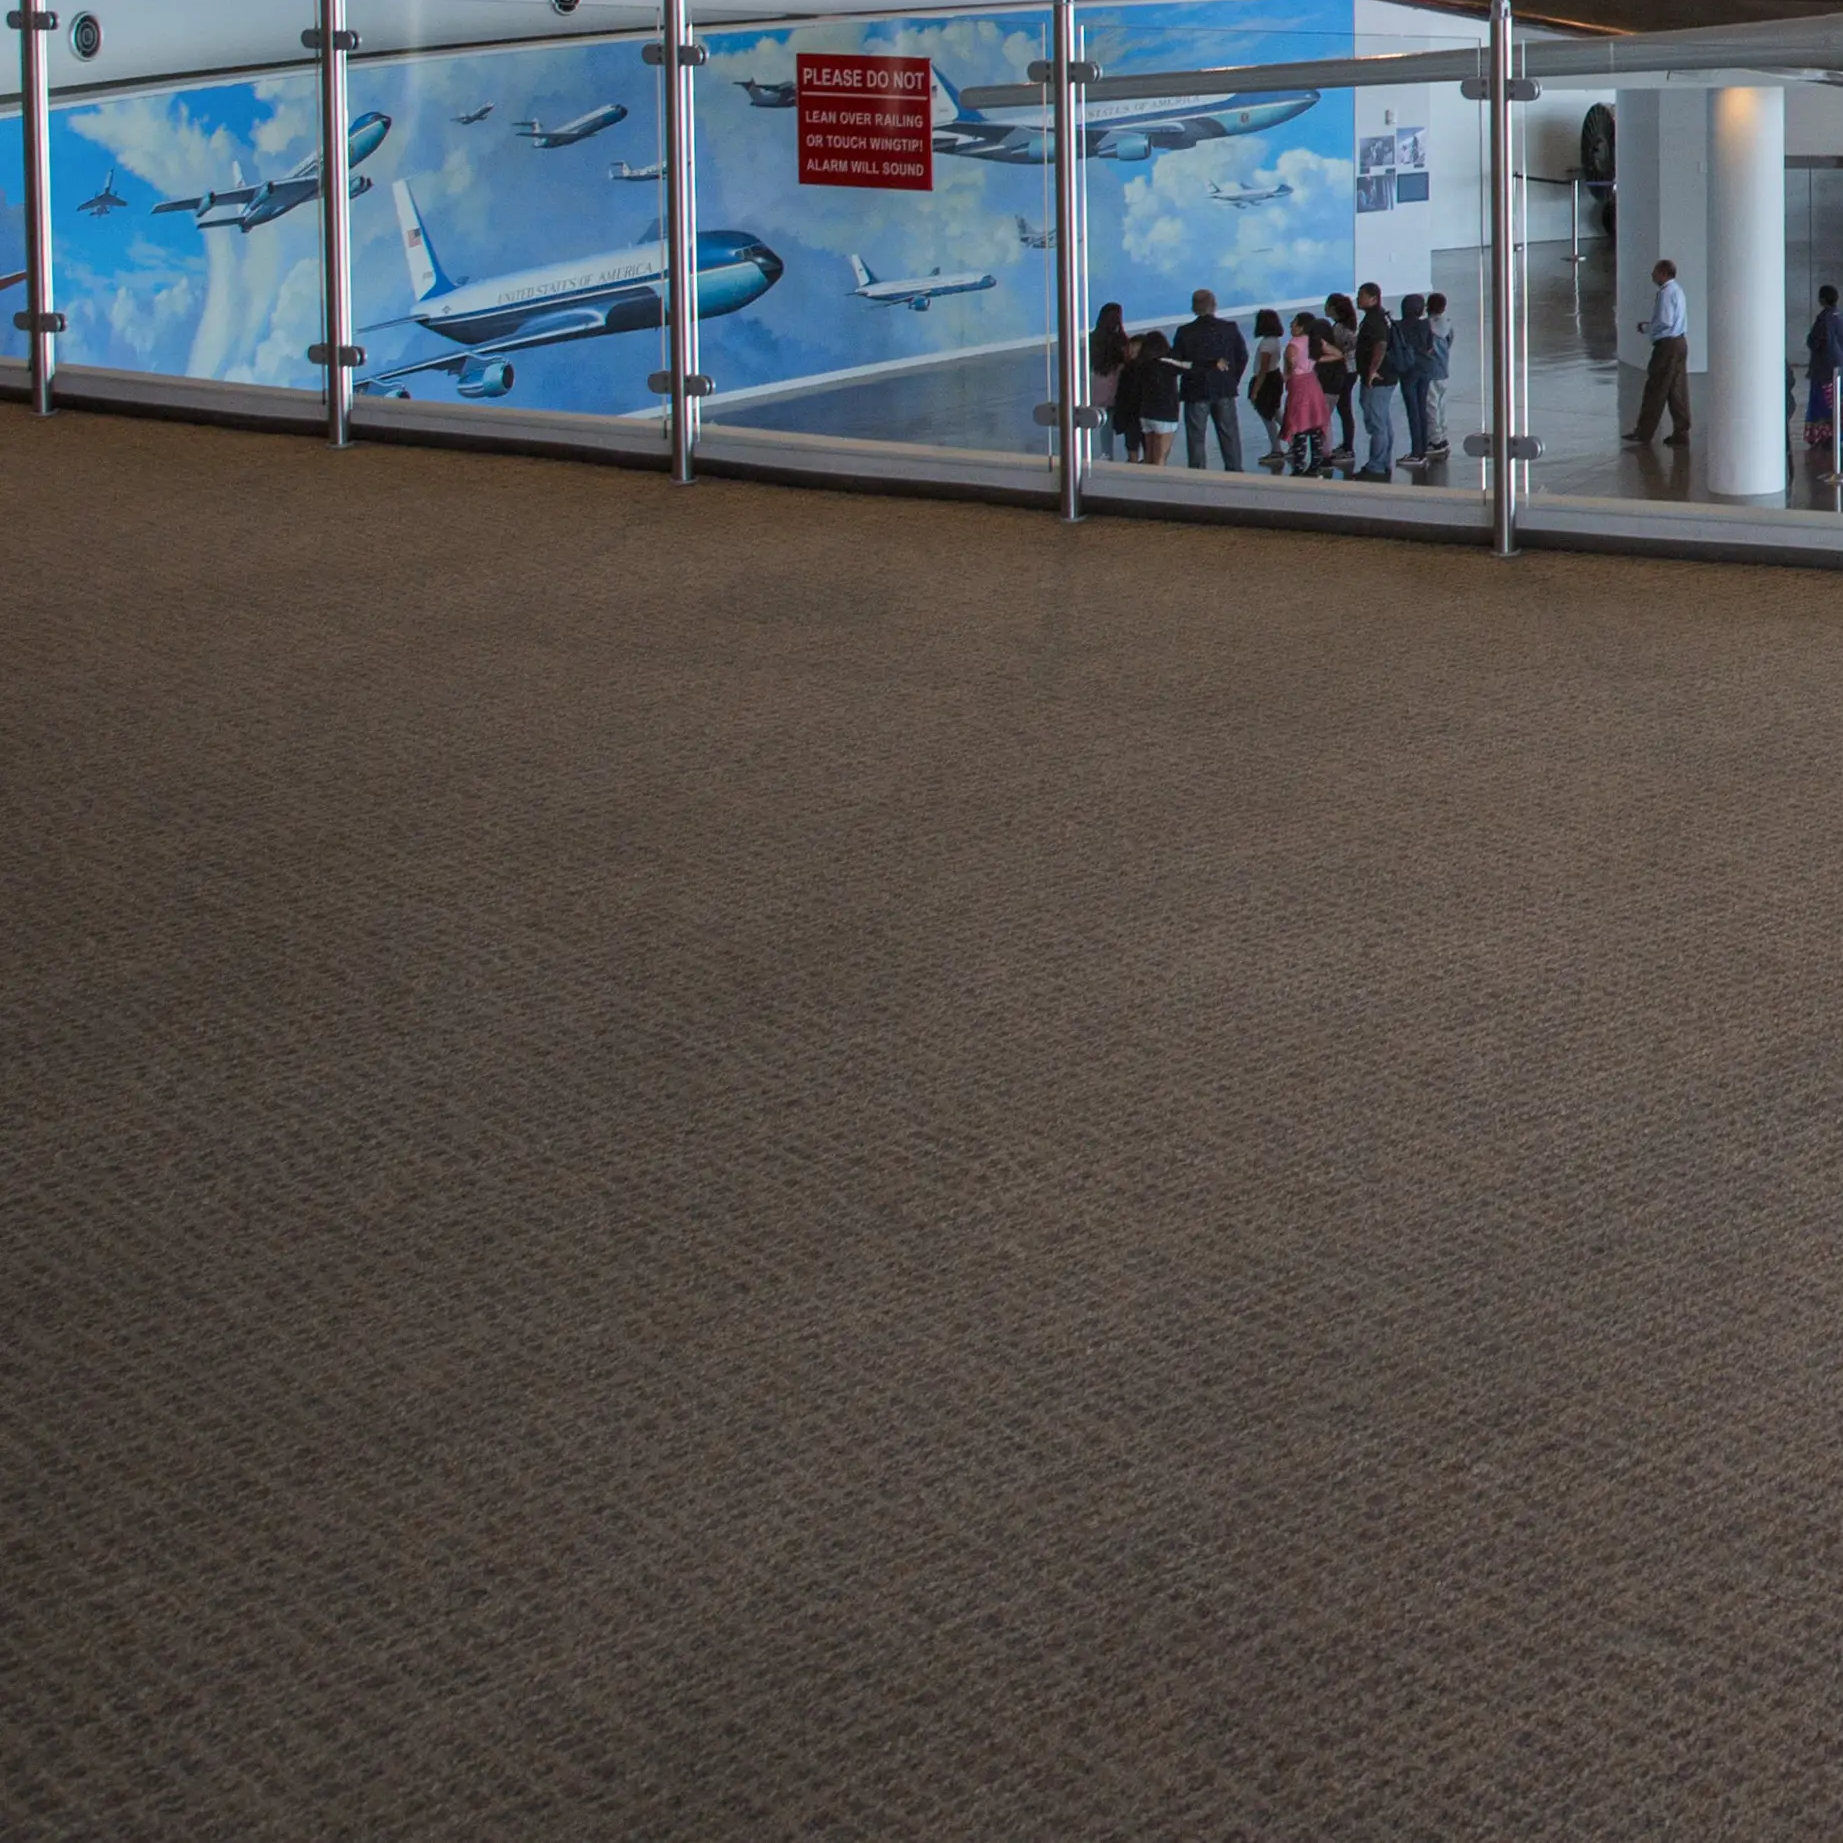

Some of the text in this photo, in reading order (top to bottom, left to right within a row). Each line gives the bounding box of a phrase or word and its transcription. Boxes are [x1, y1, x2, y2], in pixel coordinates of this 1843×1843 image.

[803, 67, 925, 90] PLEASE DO NOT
[805, 110, 924, 129] LEAN OVER RAILING
[806, 133, 924, 153] OR TOUCH WINGTIP!
[806, 158, 924, 177] ALARM WILL SOUND
[536, 278, 577, 296] STATES
[579, 272, 593, 287] OF
[599, 262, 653, 283] AMERICA
